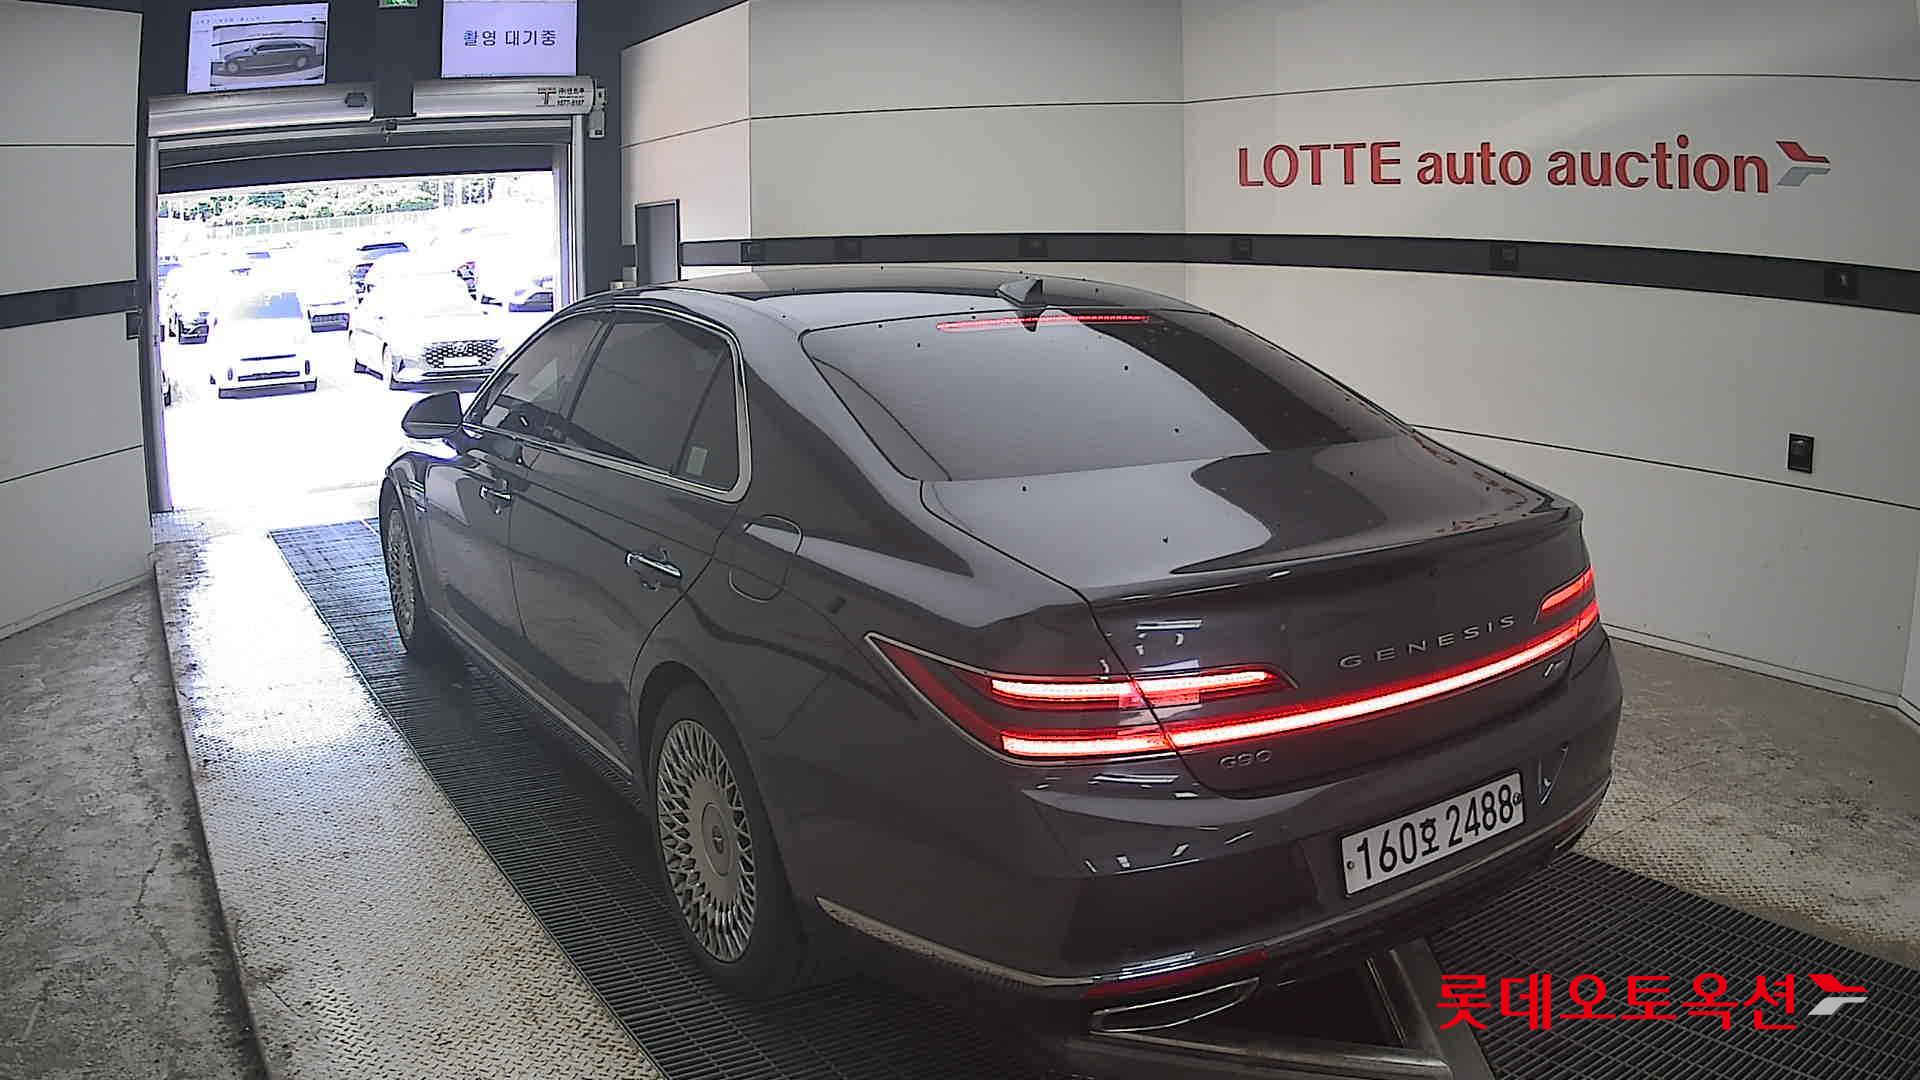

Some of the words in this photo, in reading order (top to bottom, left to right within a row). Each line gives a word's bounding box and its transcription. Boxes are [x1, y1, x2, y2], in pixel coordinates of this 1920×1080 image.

[504, 29, 557, 47] 대기중
[1238, 141, 1401, 188] LOTTE
[1416, 142, 1532, 186] auto
[1547, 133, 1769, 193] auction
[1337, 614, 1517, 669] GENESIS
[1219, 749, 1273, 769] G90
[1356, 817, 1440, 880] 160호
[1445, 783, 1514, 848] 2488
